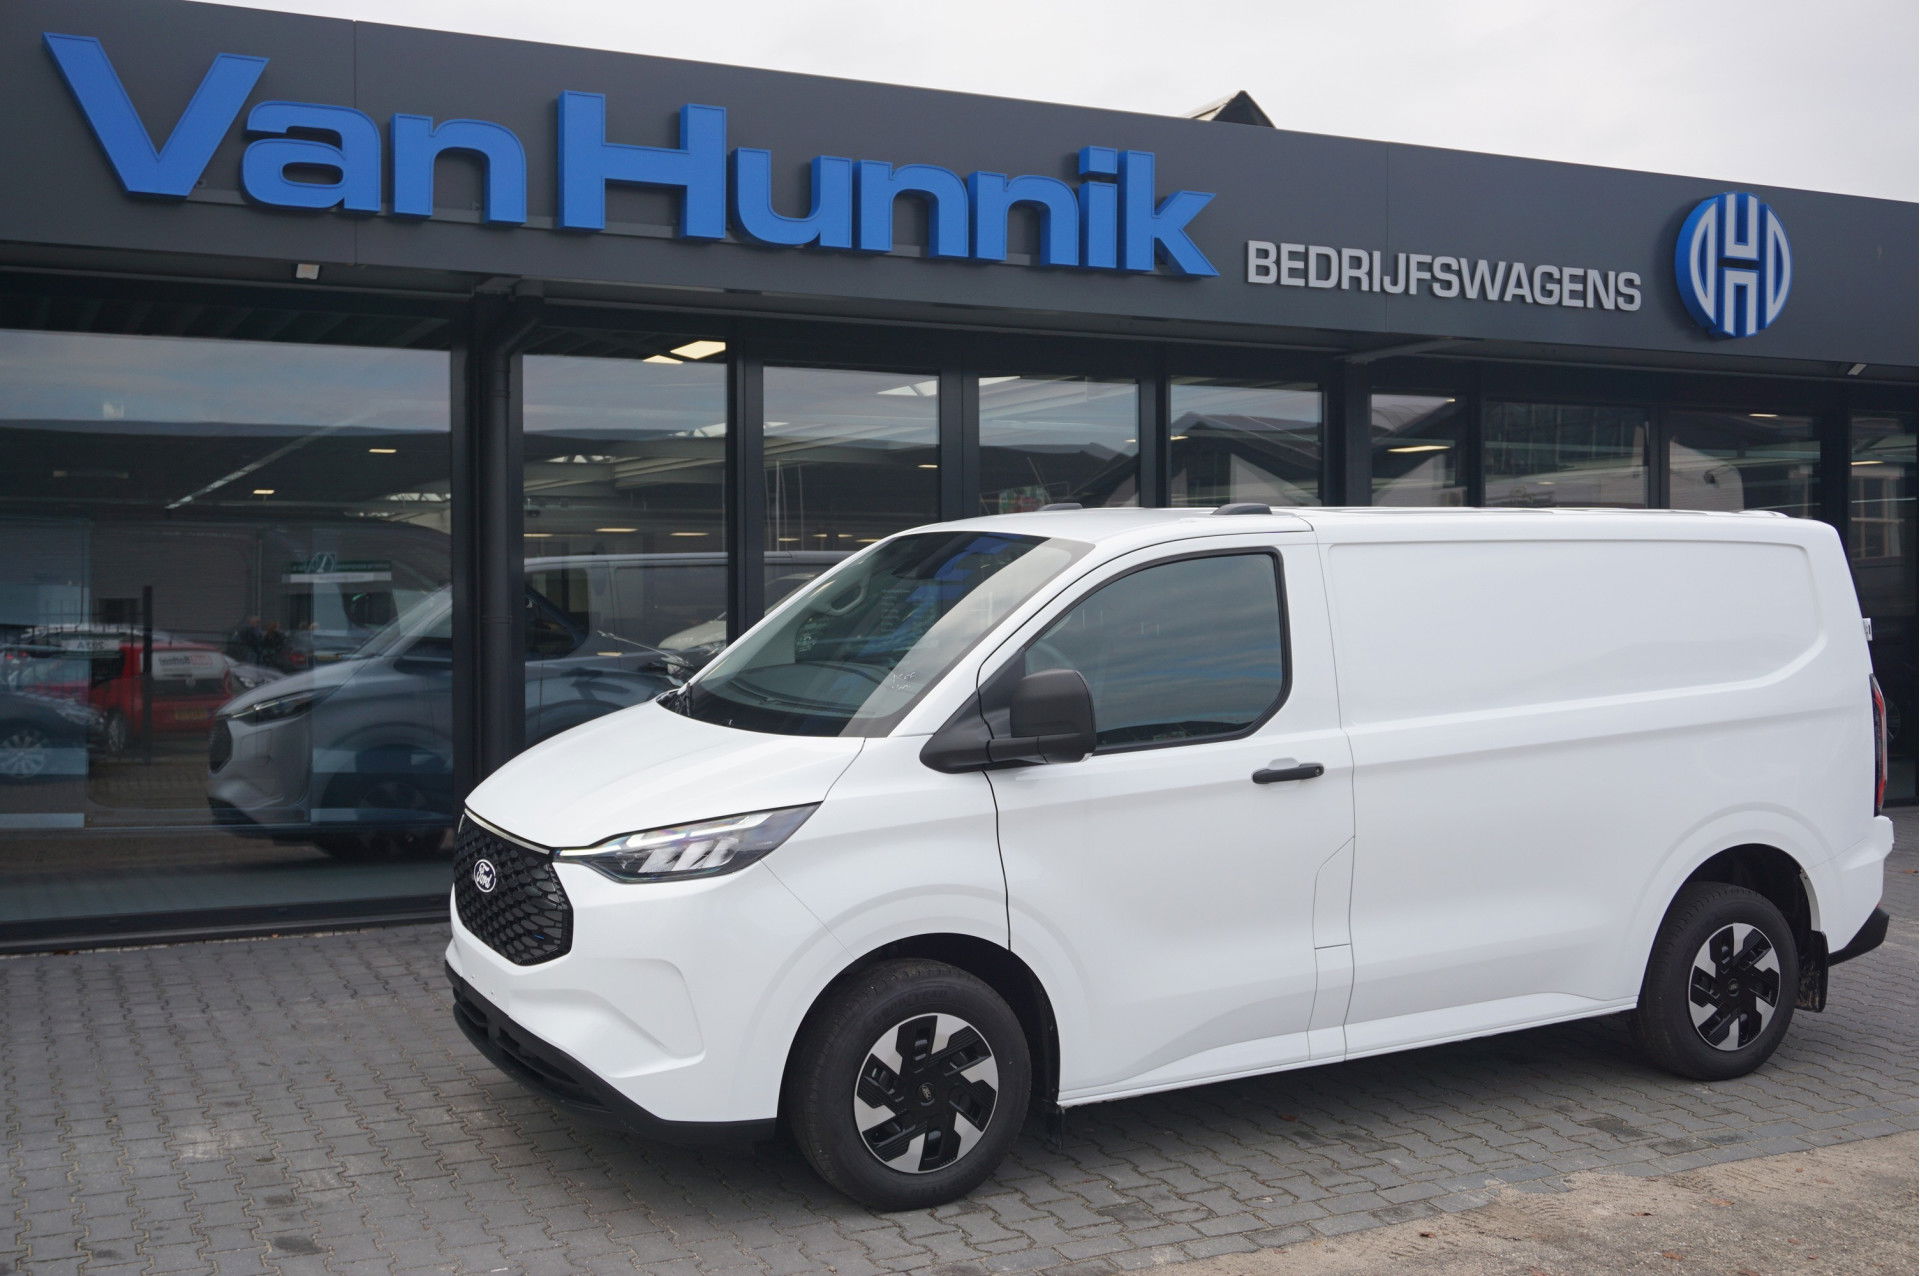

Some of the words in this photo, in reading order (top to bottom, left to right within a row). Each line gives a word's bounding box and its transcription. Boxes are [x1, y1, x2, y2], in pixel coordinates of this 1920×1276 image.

[42, 32, 528, 224] Van
[557, 89, 1221, 277] Hunnik
[1247, 240, 1642, 312] BEDRIJFSWAGENS
[476, 862, 493, 889] Ford
